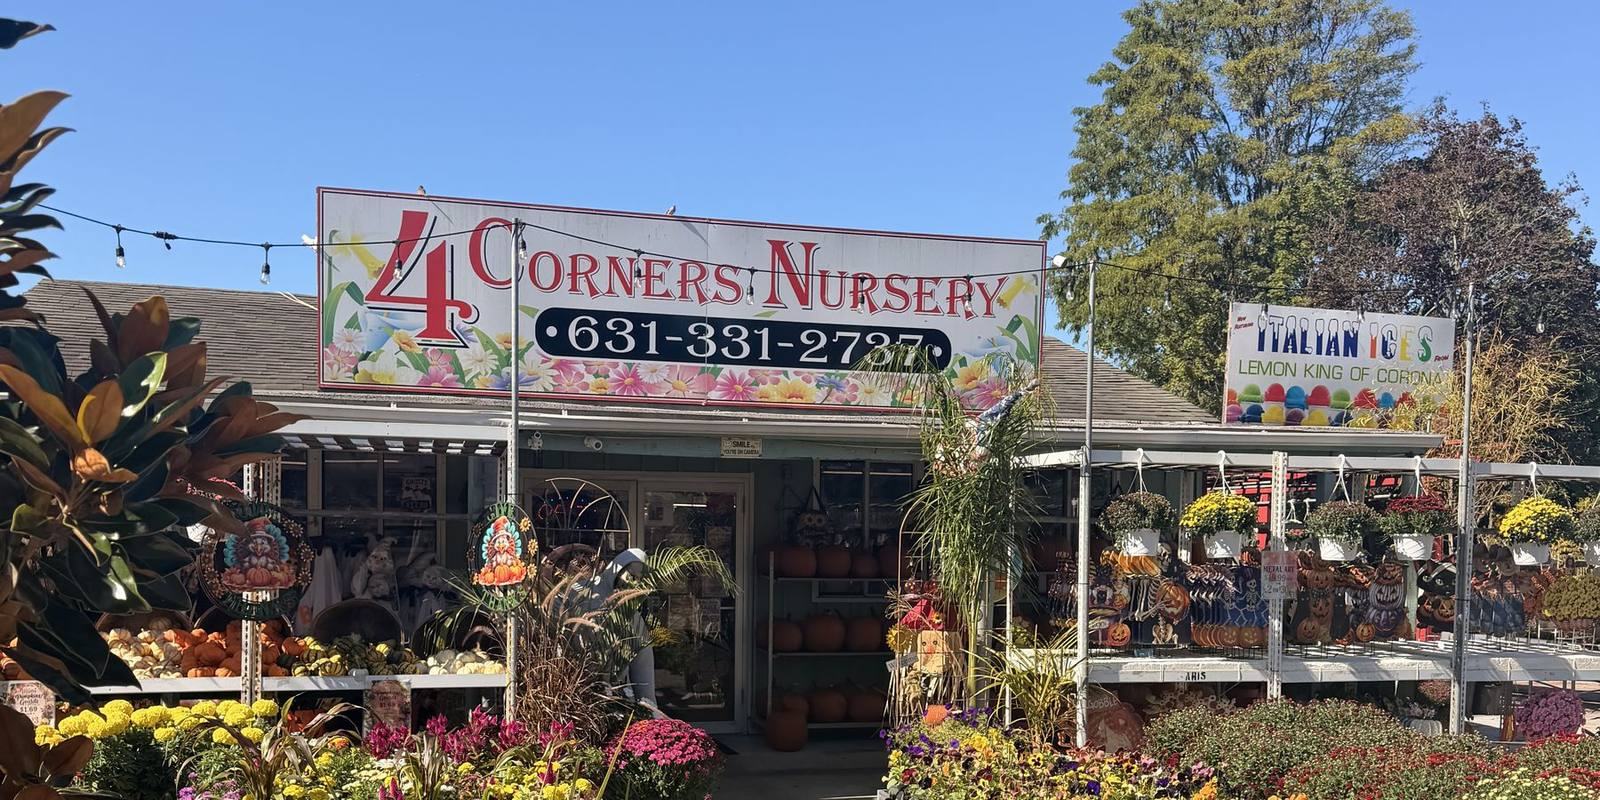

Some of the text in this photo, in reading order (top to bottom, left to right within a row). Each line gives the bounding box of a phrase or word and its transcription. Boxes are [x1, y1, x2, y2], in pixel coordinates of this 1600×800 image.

[365, 210, 1009, 348] 4 CORNERS NURSERY
[567, 315, 924, 367] 631-331-2737
[1257, 315, 1433, 362] ITALIAN ICES
[1238, 360, 1442, 385] LEMON KING OF CORONA
